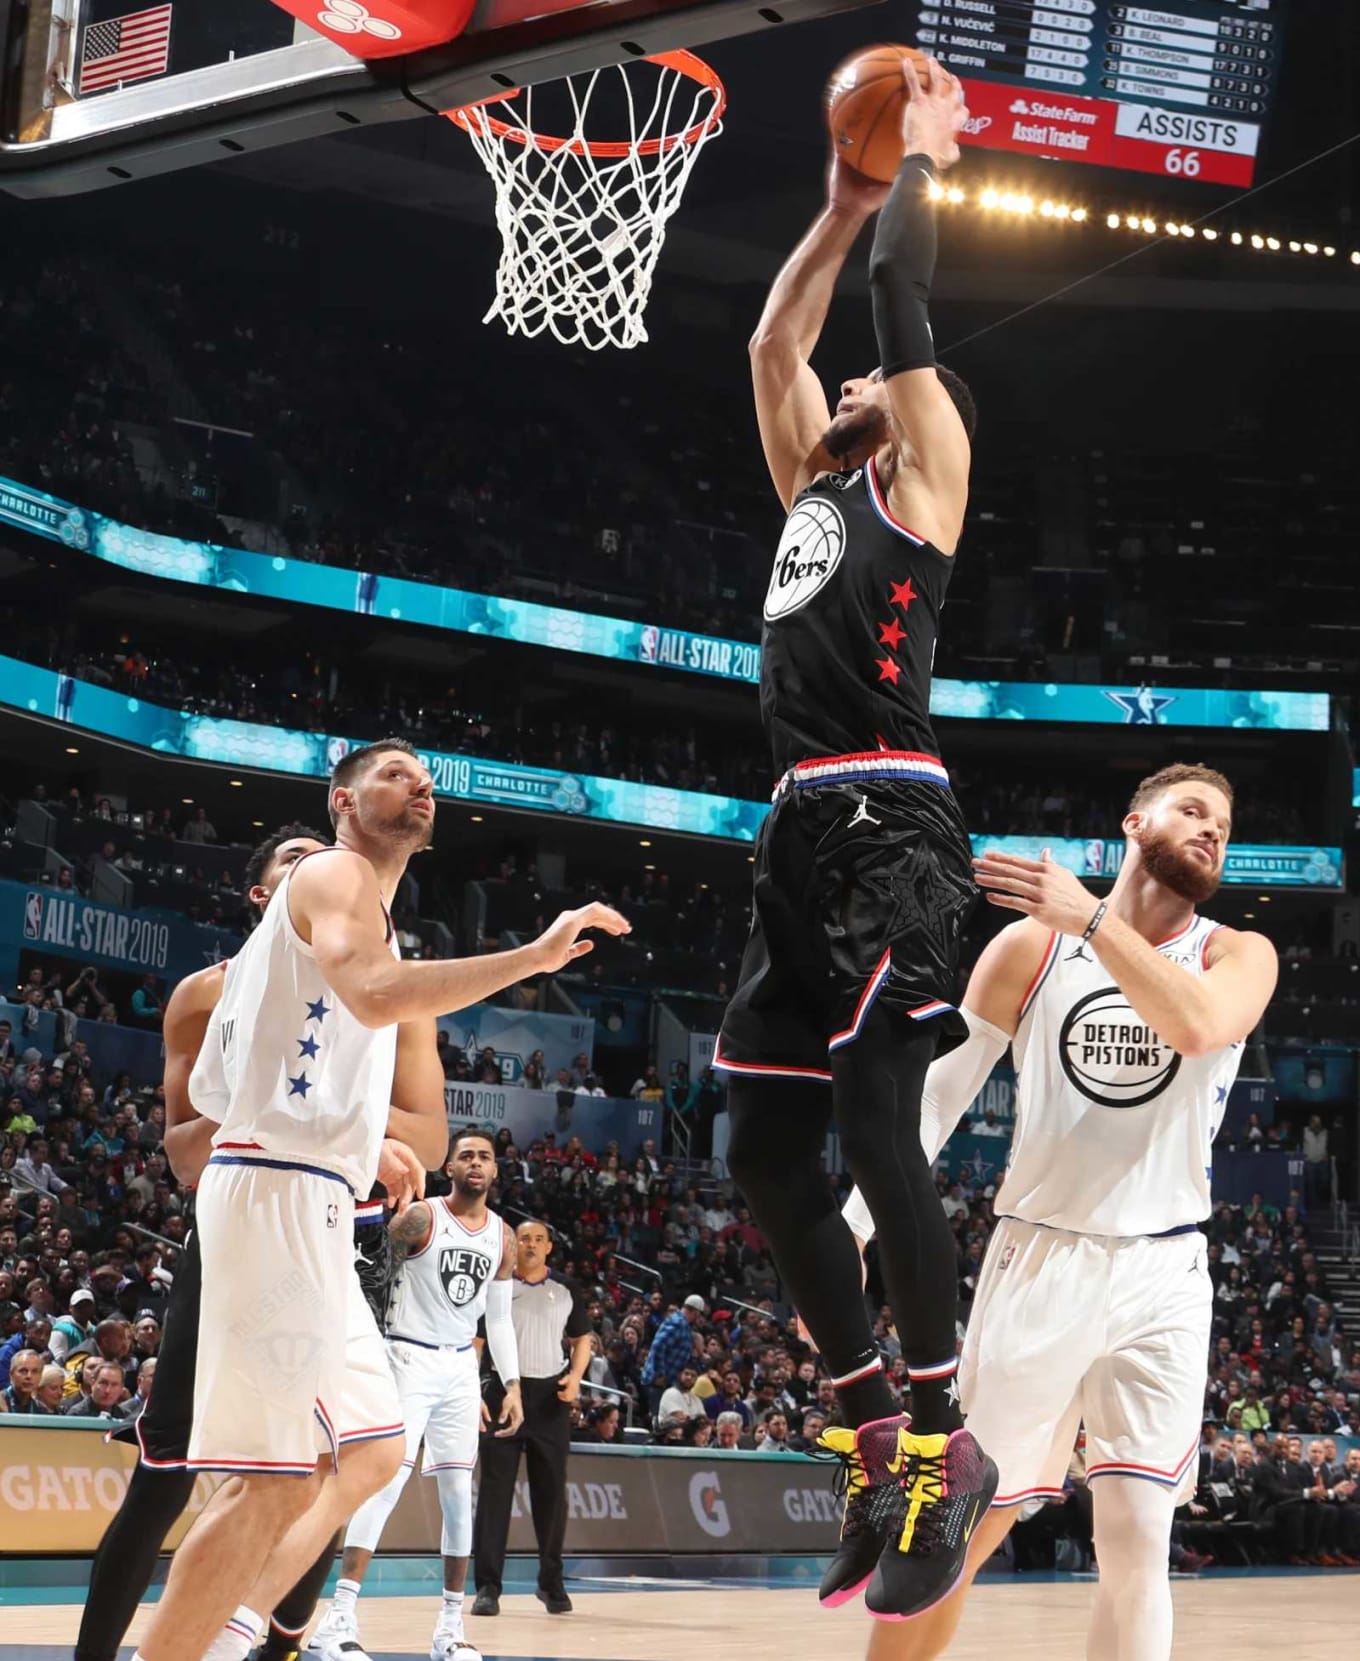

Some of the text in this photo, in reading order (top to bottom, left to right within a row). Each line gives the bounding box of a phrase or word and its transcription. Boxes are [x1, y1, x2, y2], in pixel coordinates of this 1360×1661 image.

[952, 0, 997, 15] RUSSELL
[1142, 13, 1184, 26] LEONARD
[939, 34, 949, 44] K.
[950, 35, 1006, 52] MIDDLETON
[1140, 30, 1163, 42] BEAL
[948, 53, 986, 68] GRIFFIN
[1111, 43, 1120, 53] 11
[1137, 48, 1190, 63] THOMPSON
[1215, 61, 1226, 70] 17
[1135, 66, 1179, 80] SIMMONS
[1133, 84, 1165, 97] TOWNS
[1012, 121, 1048, 144] Assist
[1048, 126, 1090, 151] Tracker
[1136, 113, 1238, 147] ASSISTS
[1164, 149, 1200, 177] 66
[0, 492, 57, 525] HARLOTTE
[776, 546, 829, 588] 6ers
[733, 645, 761, 680] 201
[432, 756, 470, 793] 2019
[476, 775, 548, 795] CHARLOTTE
[1228, 858, 1299, 871] CHARLOTTE
[128, 918, 169, 969] 2019
[1082, 1045, 1161, 1067] PISTONS
[475, 1091, 505, 1120] 2019
[441, 1250, 491, 1281] NETS
[456, 1278, 466, 1300] B
[688, 1471, 731, 1538] G
